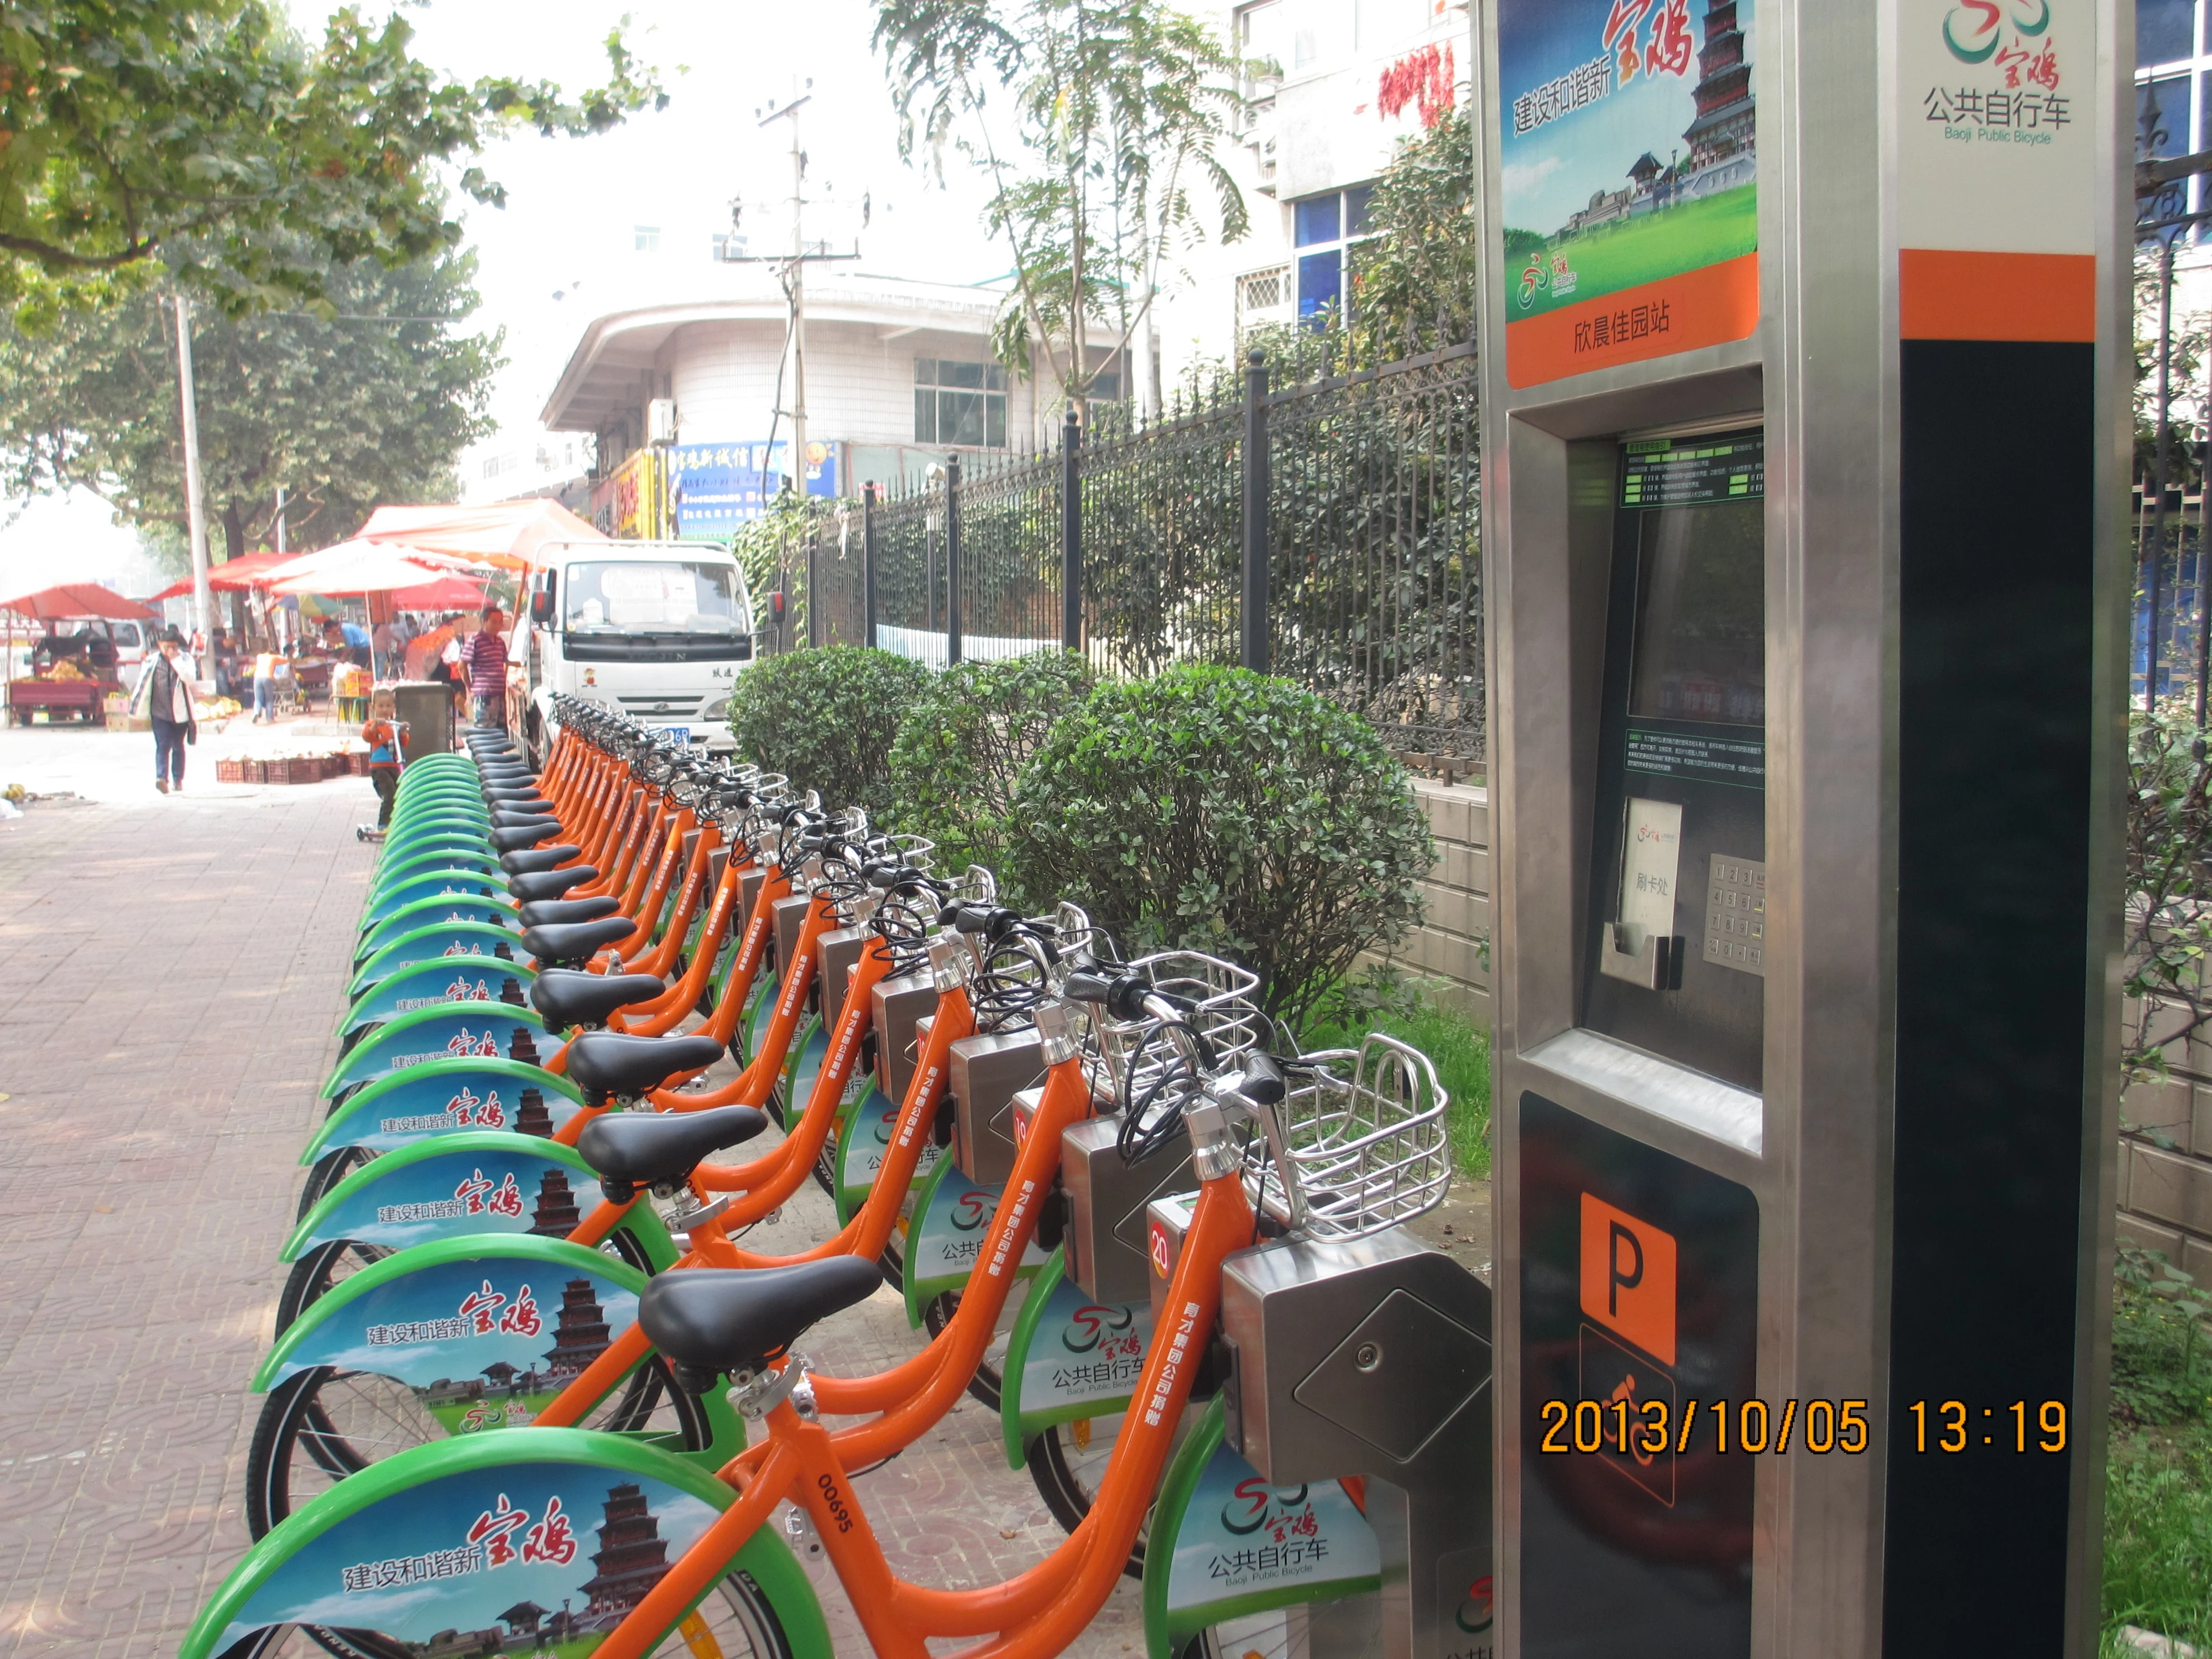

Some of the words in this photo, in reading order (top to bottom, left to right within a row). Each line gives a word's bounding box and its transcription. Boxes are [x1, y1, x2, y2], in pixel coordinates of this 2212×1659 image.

[1513, 53, 1611, 138] 建设和谐新
[1923, 86, 2072, 131] 公共自行车
[1944, 126, 1972, 143] Baoji
[1978, 128, 2011, 144] Public
[2013, 130, 2052, 147] Bicycle
[1573, 299, 1670, 354] 欣晨佳园站
[1636, 872, 1669, 896] 刷卡处
[380, 1113, 455, 1134] 建设和谐新
[377, 1198, 465, 1224] 建设和谐新
[988, 1180, 1036, 1277] 育才集团公司捐赠
[1152, 1229, 1168, 1270] 20
[1609, 1220, 1644, 1317] P
[367, 1316, 471, 1347] 建设和谐新
[458, 1279, 543, 1339] 宝鸡
[1144, 1301, 1201, 1427] 育才集团公司捐赠
[1088, 1383, 1111, 1392] Public
[818, 1473, 853, 1533] 00695
[342, 1544, 483, 1593] 建设和谐新
[465, 1491, 578, 1567] 宝鸡
[1208, 1537, 1330, 1580] 公共自行车
[1225, 1573, 1248, 1587] Baoji
[1252, 1568, 1279, 1583] Public
[1281, 1563, 1313, 1578] Bicycle
